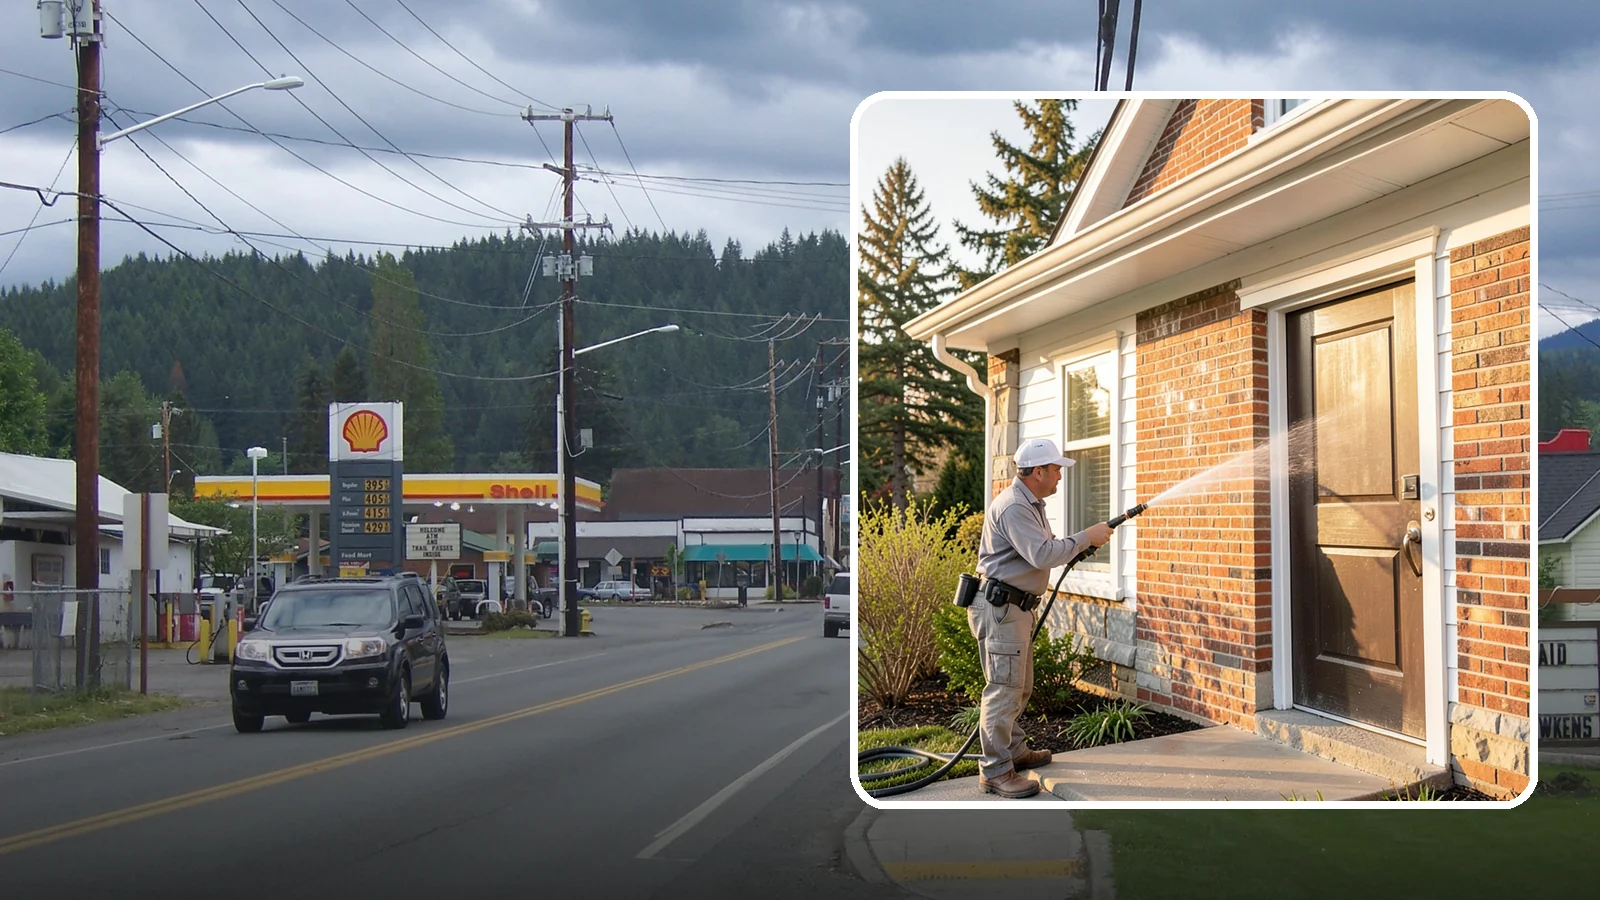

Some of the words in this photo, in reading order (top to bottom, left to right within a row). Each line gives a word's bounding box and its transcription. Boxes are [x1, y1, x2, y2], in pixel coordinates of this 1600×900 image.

[366, 480, 383, 490] 395
[490, 484, 547, 499] Shell
[366, 494, 383, 504] 405
[366, 508, 383, 518] 415
[366, 522, 383, 532] 429
[1539, 643, 1566, 666] AID
